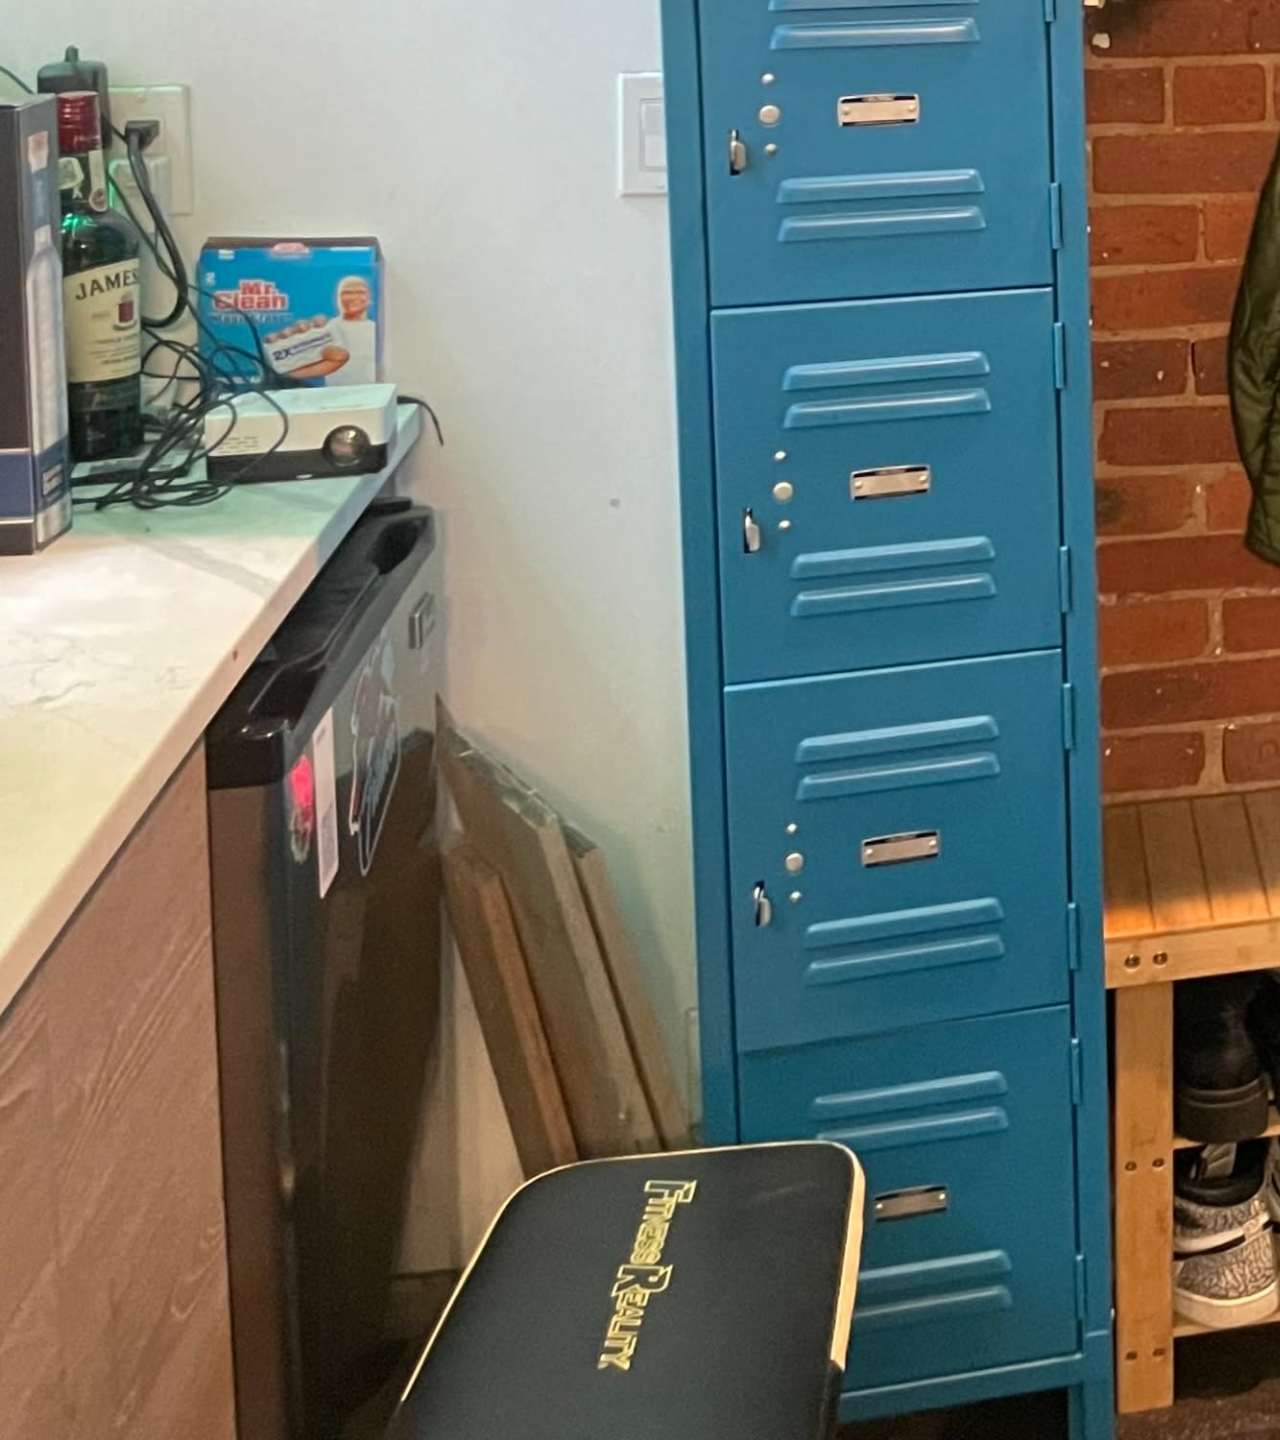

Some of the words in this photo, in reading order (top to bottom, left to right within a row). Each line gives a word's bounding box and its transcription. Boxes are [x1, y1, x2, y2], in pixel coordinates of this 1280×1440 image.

[213, 291, 288, 310] Clean
[630, 1180, 698, 1265] FITNESS
[598, 1264, 674, 1371] REALITY
